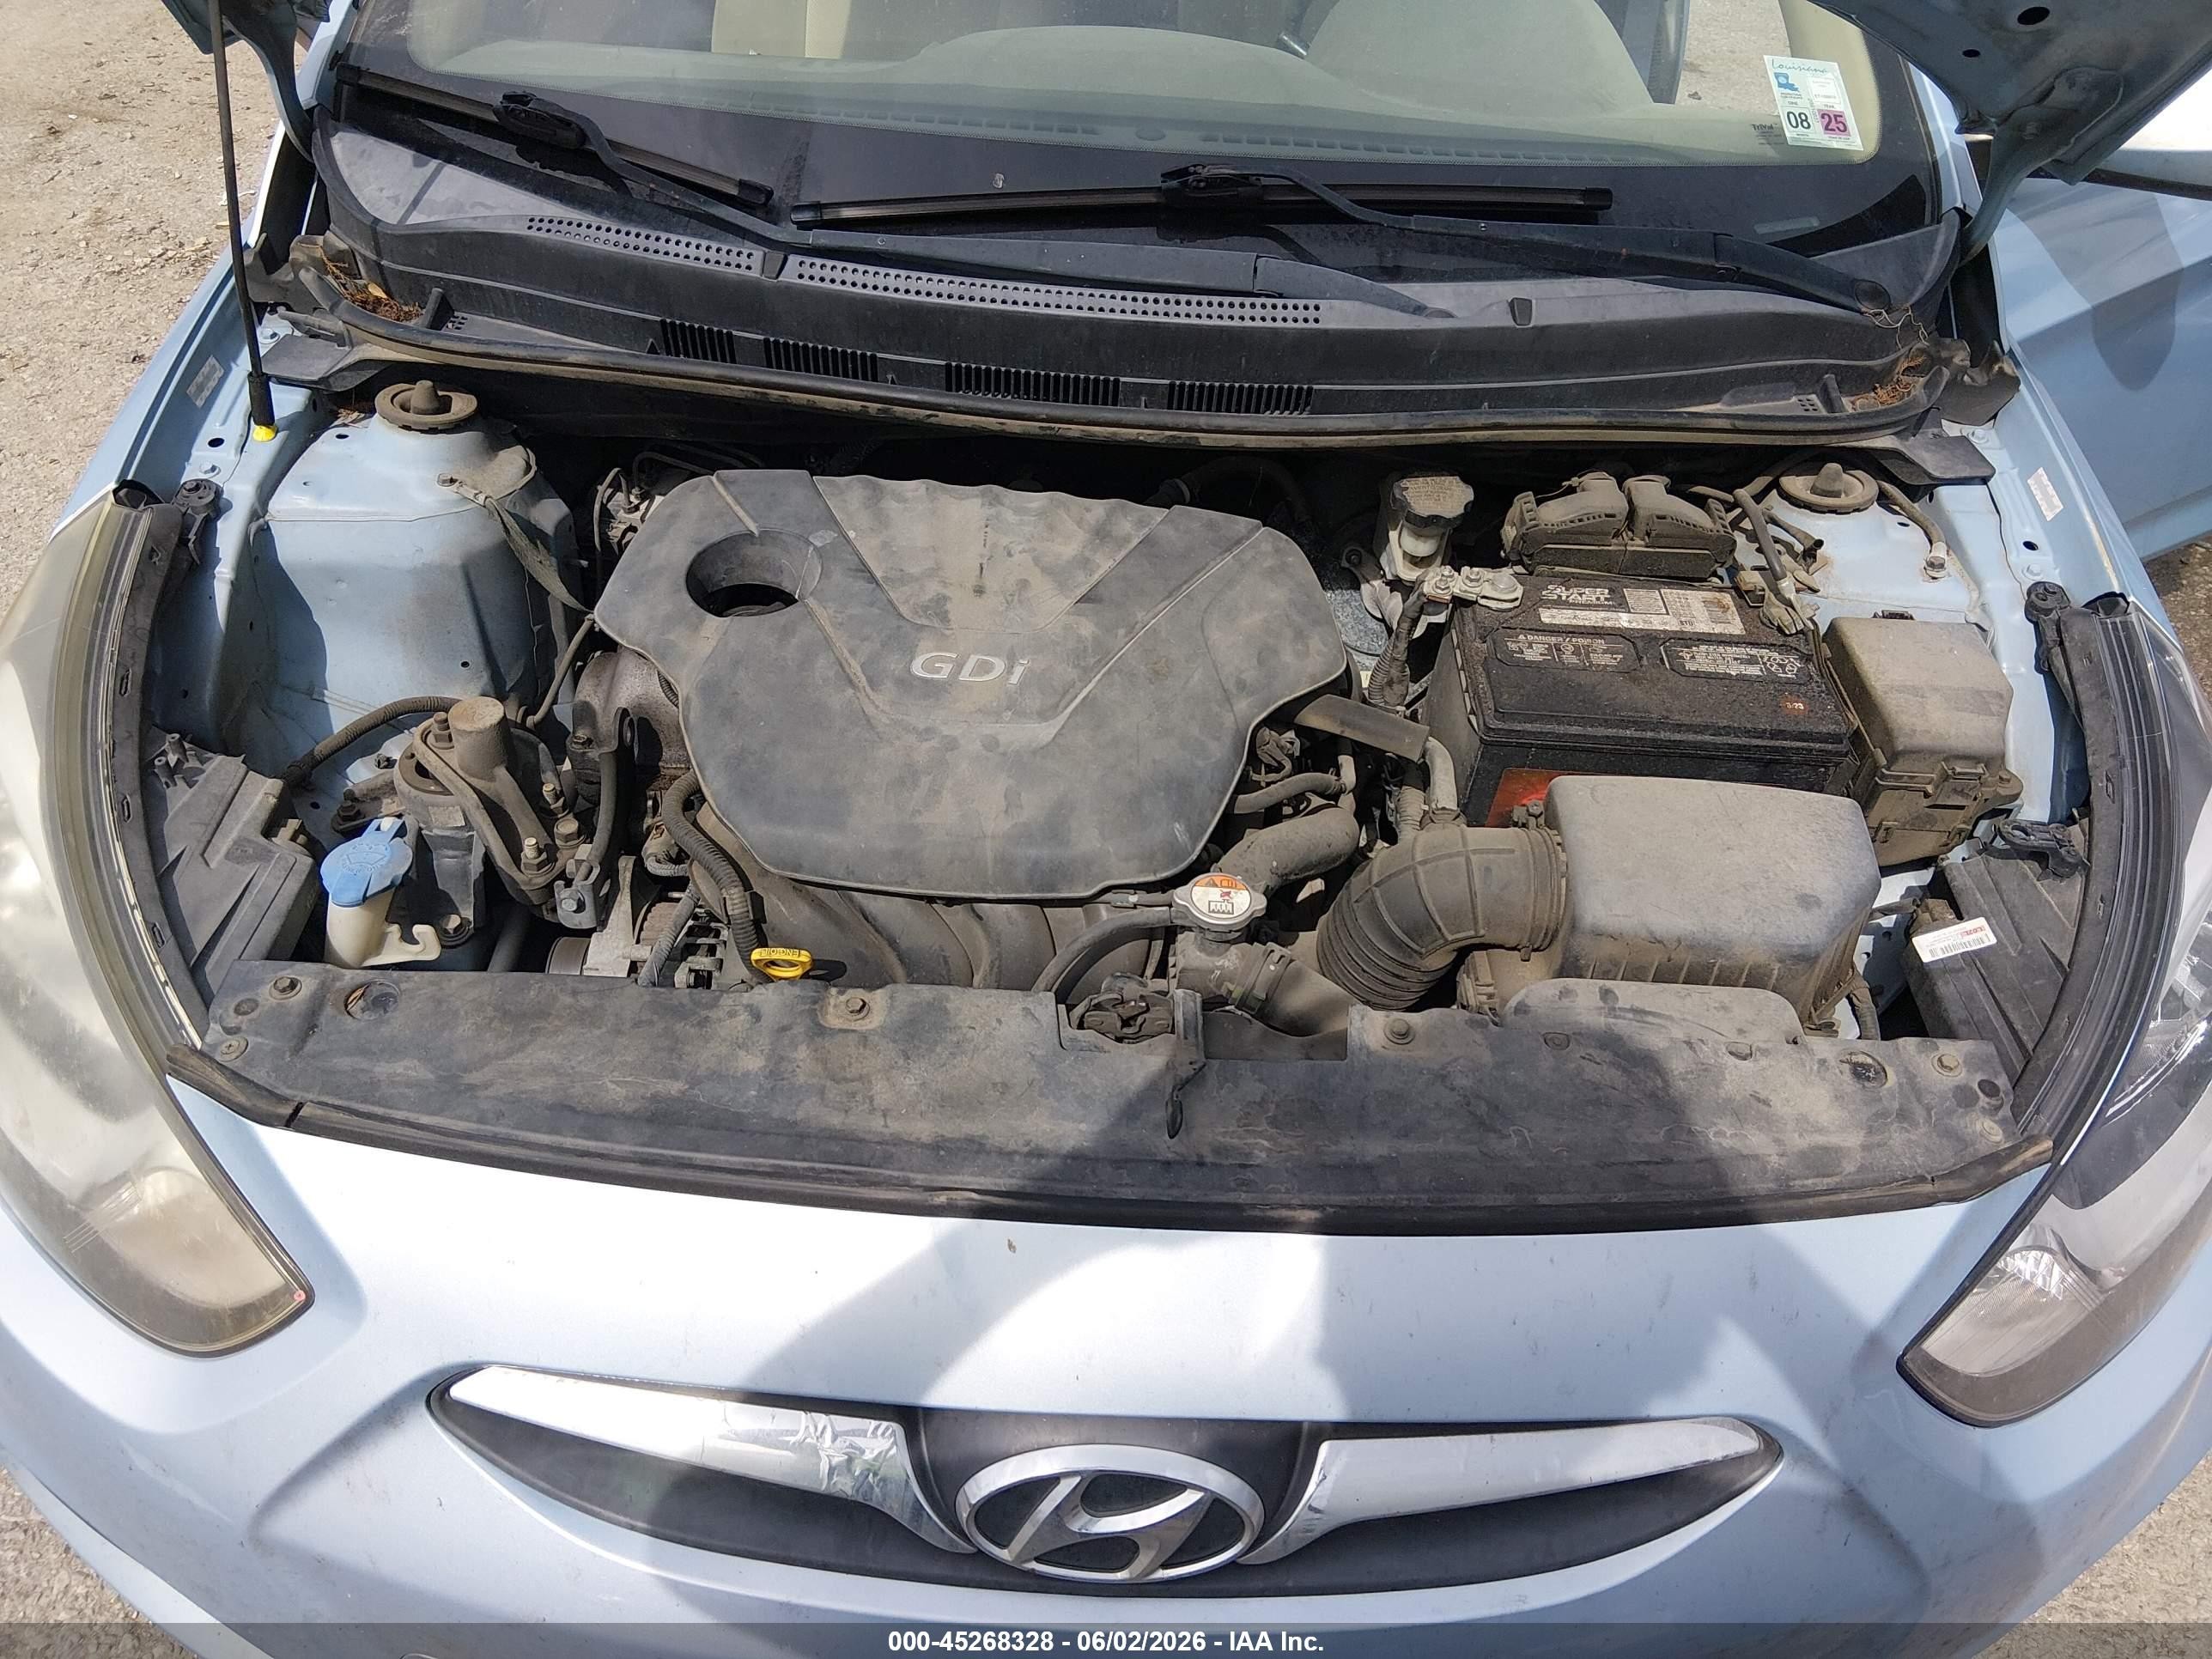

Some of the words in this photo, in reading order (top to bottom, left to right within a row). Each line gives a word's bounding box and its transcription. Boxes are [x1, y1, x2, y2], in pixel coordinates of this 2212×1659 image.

[1771, 58, 1828, 74] Louisiana
[1786, 111, 1811, 130] 08
[1820, 112, 1848, 133] 25
[1540, 590, 1611, 602] START
[1547, 584, 1610, 595] SUPER
[910, 653, 1030, 685] GDi
